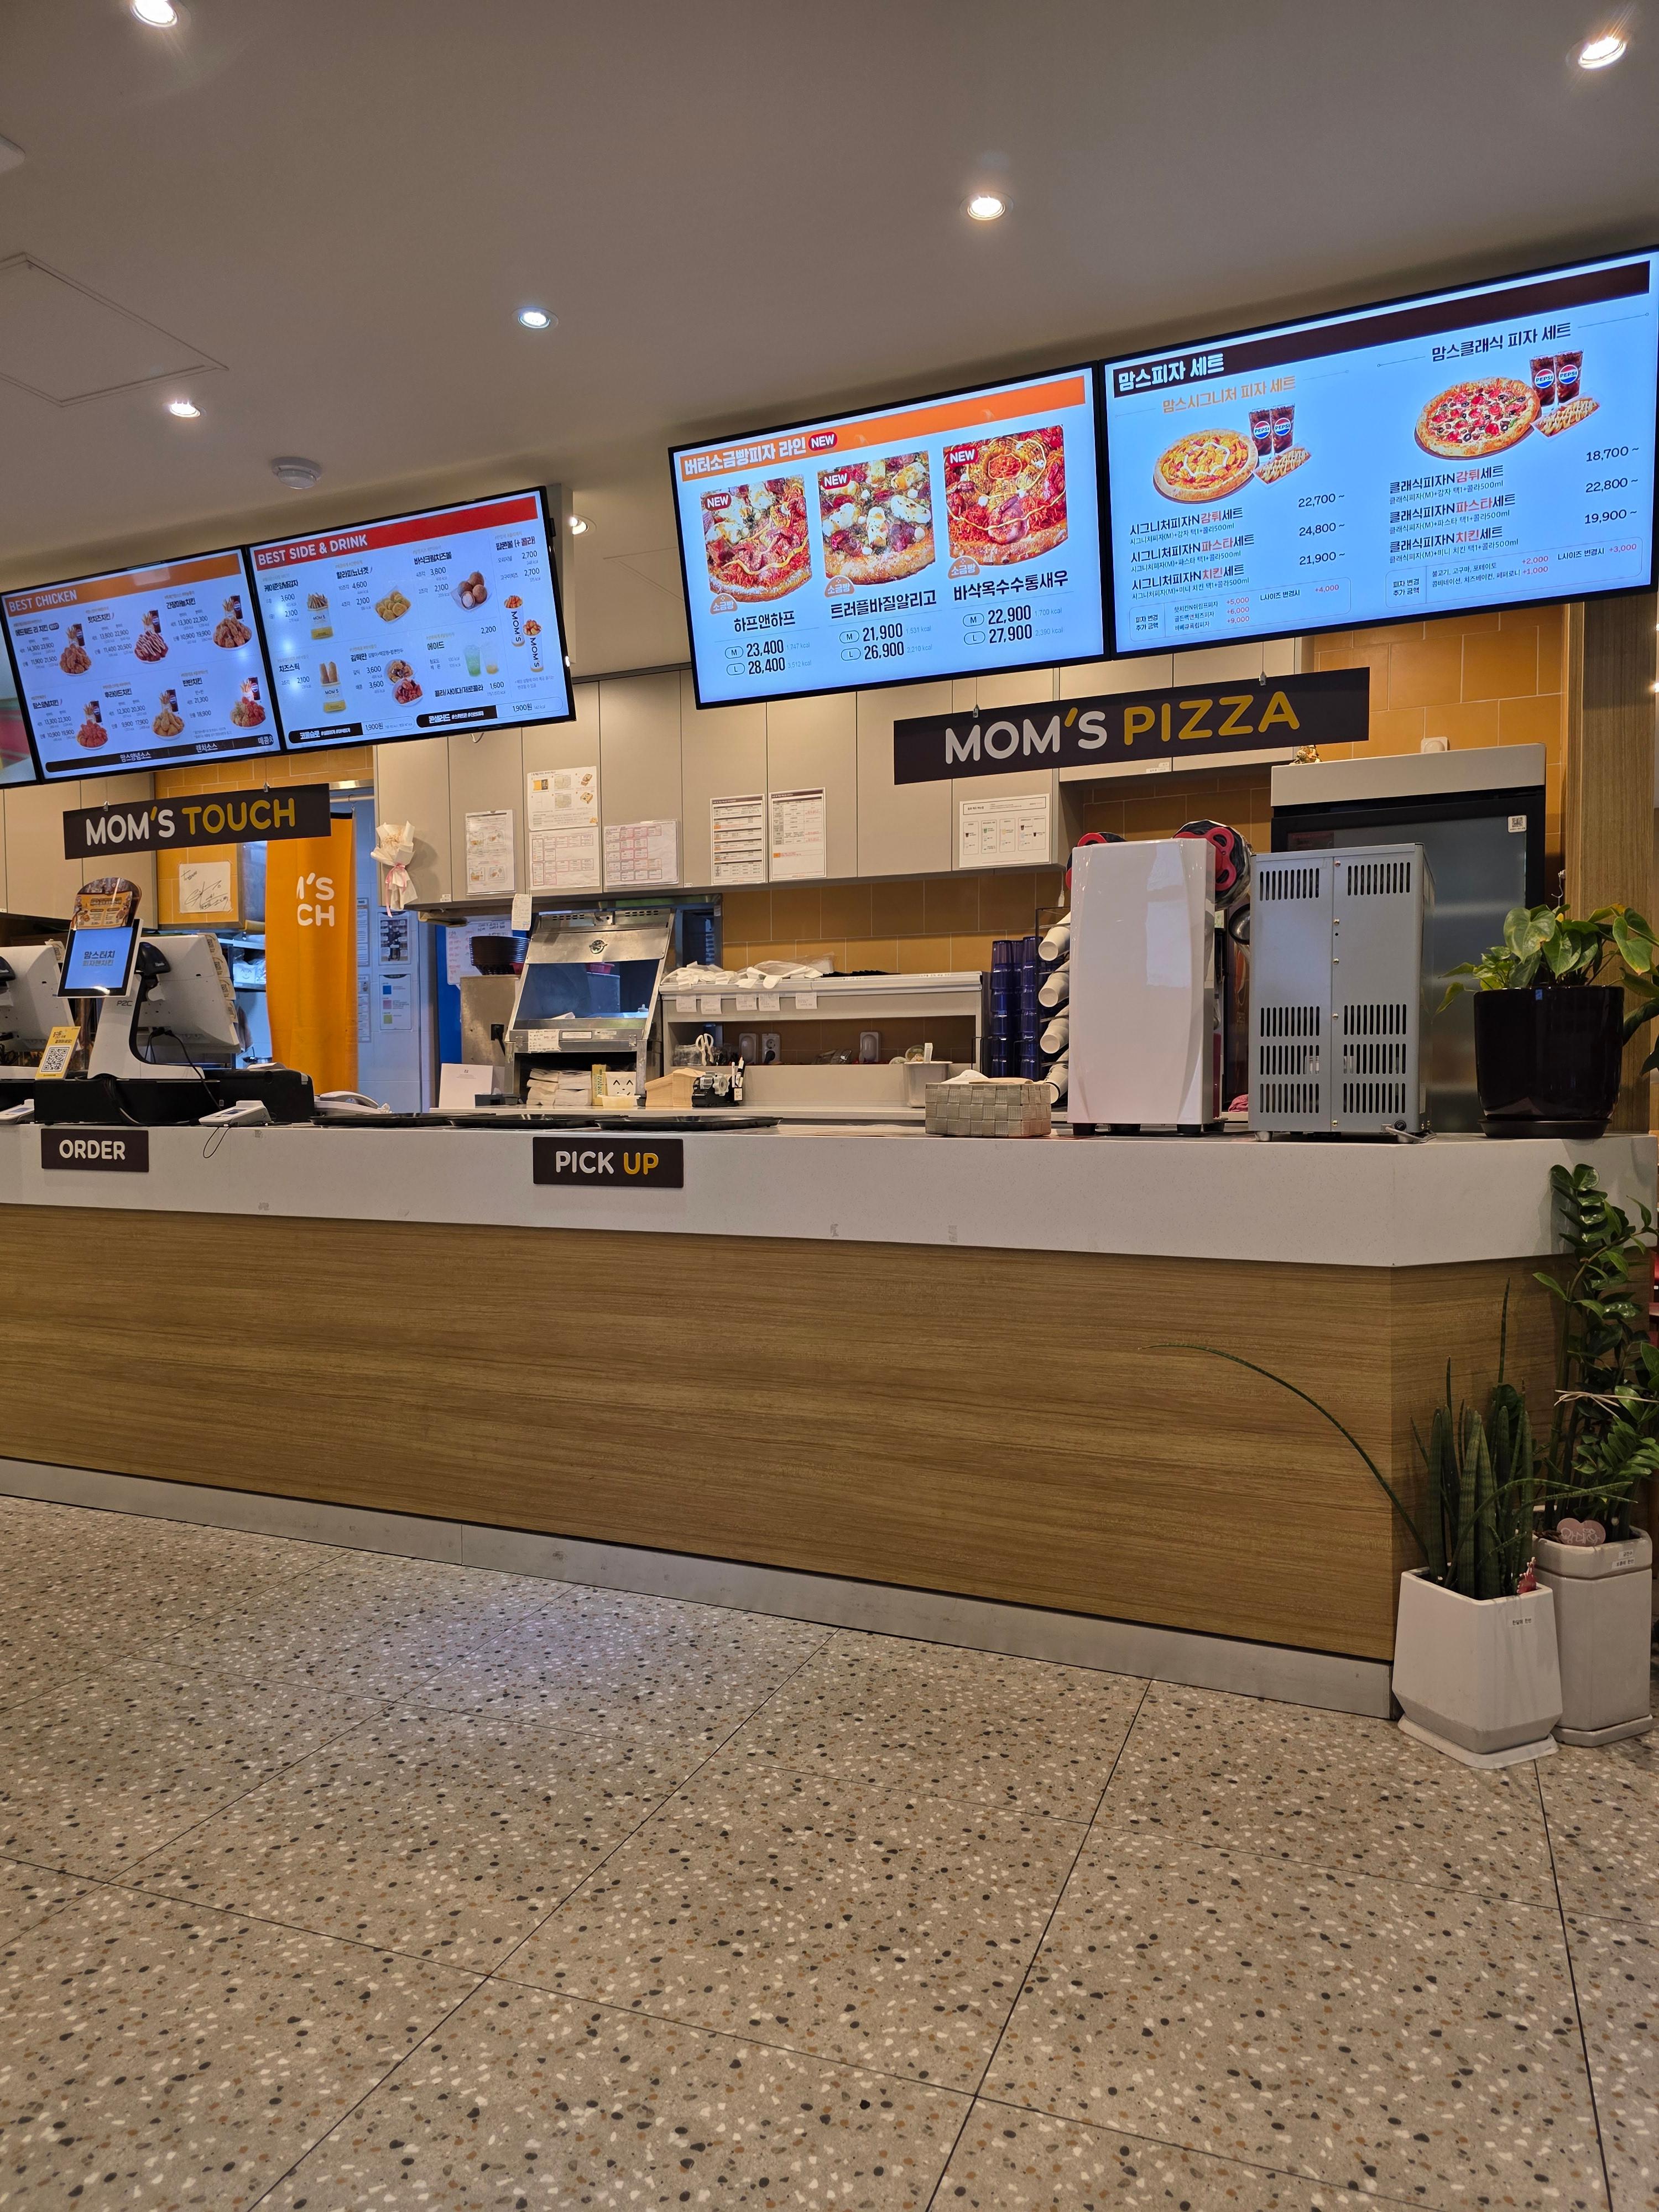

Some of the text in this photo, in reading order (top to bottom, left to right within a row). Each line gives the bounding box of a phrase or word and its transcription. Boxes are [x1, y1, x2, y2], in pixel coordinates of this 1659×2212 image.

[1432, 322, 1571, 362] 맘스클래식 피자 세트
[1118, 352, 1225, 392] 맘스피자 세트
[1162, 375, 1296, 413] 맘스시그니처 피자 세트
[685, 434, 835, 476] 버터소금빵피자 라인 NEW
[950, 449, 975, 463] NEW
[1586, 446, 1629, 462] 18,700
[823, 473, 847, 487] NEW
[1390, 465, 1504, 494] 클래식피자N감튀세트
[1585, 477, 1628, 493] 22,800
[707, 496, 729, 508] NEW
[1298, 493, 1336, 508] 22,700
[1390, 494, 1516, 523] 클래식피자N파스타세트
[1130, 507, 1243, 535] 시그니처피자N감튀세트
[1584, 509, 1627, 524] 19,900
[1299, 523, 1337, 536] 24,800
[1390, 526, 1503, 553] 클래식피자N치킨세트
[258, 534, 367, 566] BEST SIDE & DRINK
[522, 550, 538, 560] 2,700
[1131, 534, 1255, 563] 시그니처피자N파스타세트
[1453, 545, 1466, 554] 치킨
[1609, 544, 1637, 552] +3,000
[1300, 551, 1337, 565] 21,900
[1522, 555, 1548, 565] +2,000
[430, 567, 446, 576] 3,800
[524, 567, 540, 577] 2,700
[951, 564, 976, 576] 소금빵
[1522, 566, 1548, 575] +1,000
[1131, 564, 1245, 591] 시그니처피자N치킨세트
[1393, 580, 1405, 588] 피자
[352, 581, 367, 589] 4,600
[435, 583, 449, 592] 2,100
[827, 583, 850, 594] 소금빵
[954, 570, 1068, 601] 바삭옥수수통새우
[1314, 584, 1339, 593] +4,000
[9, 589, 77, 612] BEST CHICKEN
[281, 593, 295, 602] 3,600
[357, 597, 370, 606] 2,100
[831, 589, 937, 619] 트러플바질알리고
[285, 609, 298, 618] 2,100
[713, 601, 734, 612] 소금빵
[734, 611, 796, 632] 하프앤하프
[988, 605, 1031, 625] 22,900
[481, 625, 497, 634] 2,200
[863, 623, 903, 641] 21,900
[989, 624, 1032, 644] 27,900
[427, 641, 445, 650] 에이드
[747, 639, 784, 658] 23,400
[864, 641, 904, 660] 26,900
[279, 663, 300, 672] 치즈스틱
[367, 665, 382, 674] 3,600
[748, 657, 786, 675] 28,400
[297, 676, 310, 685] 2,100
[369, 680, 384, 689] 3,600
[489, 681, 504, 691] 1,600
[513, 703, 533, 712] 1,900원
[365, 722, 384, 731] 1,900원
[945, 691, 1300, 764] MOM'S PIZZA
[86, 798, 295, 846] MOM'S TOUCH
[84, 950, 115, 959] 맘스터치
[59, 1139, 126, 1160] ORDER
[556, 1151, 659, 1175] PICK UP
